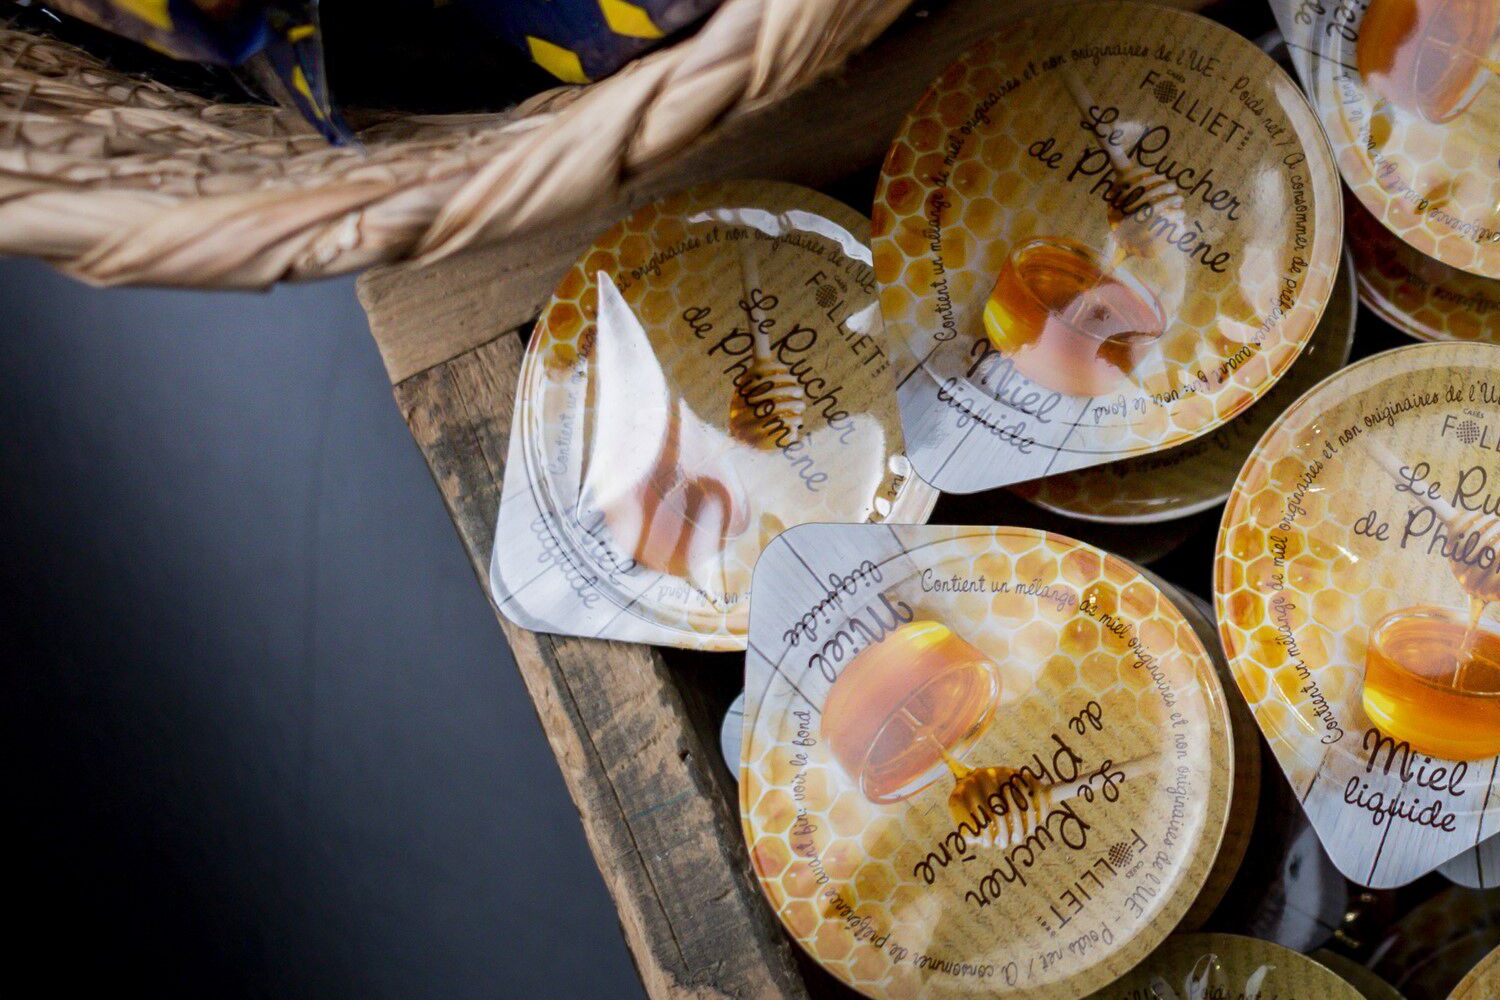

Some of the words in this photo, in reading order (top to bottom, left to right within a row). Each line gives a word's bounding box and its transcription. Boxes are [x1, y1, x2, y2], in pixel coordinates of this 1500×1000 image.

[1080, 104, 1125, 147] Le
[1127, 124, 1239, 222] Rucher
[1231, 75, 1265, 116] Poids
[1290, 175, 1308, 254] consommer
[1027, 137, 1063, 169] de
[1066, 147, 1230, 274] Philomène
[739, 289, 779, 334] Le
[769, 323, 856, 446] Rucher
[965, 337, 1063, 424] Miel
[1445, 386, 1463, 403] de
[682, 306, 714, 339] de
[707, 327, 828, 492] Philomène
[936, 377, 1037, 456] liquide
[1364, 392, 1439, 427] originaires
[1324, 441, 1338, 460] et
[1339, 426, 1362, 446] non
[1279, 461, 1324, 532] originaires
[1395, 462, 1441, 499] Le
[1274, 535, 1288, 566] miel
[1354, 511, 1389, 541] de
[783, 560, 883, 647] liquide
[920, 568, 986, 593] Contient
[1015, 577, 1075, 611] mélange
[1273, 565, 1286, 590] de
[809, 593, 913, 683] Miel
[1100, 611, 1130, 639] miel
[1275, 595, 1301, 658] mélange
[1128, 636, 1176, 707] originaires
[1294, 660, 1311, 682] un
[792, 709, 817, 748] fond
[1069, 700, 1102, 736] de
[1300, 681, 1343, 745] Contient
[1174, 732, 1188, 760] non
[1363, 728, 1469, 797] Miel
[913, 733, 1082, 885] Philomène
[1077, 760, 1125, 802] Le
[1164, 766, 1193, 848] originaires
[1344, 775, 1456, 832] liquide
[965, 800, 1090, 908] Rucher
[824, 886, 892, 949] préférence
[1069, 921, 1114, 954] Poids
[913, 951, 994, 978] consommer
